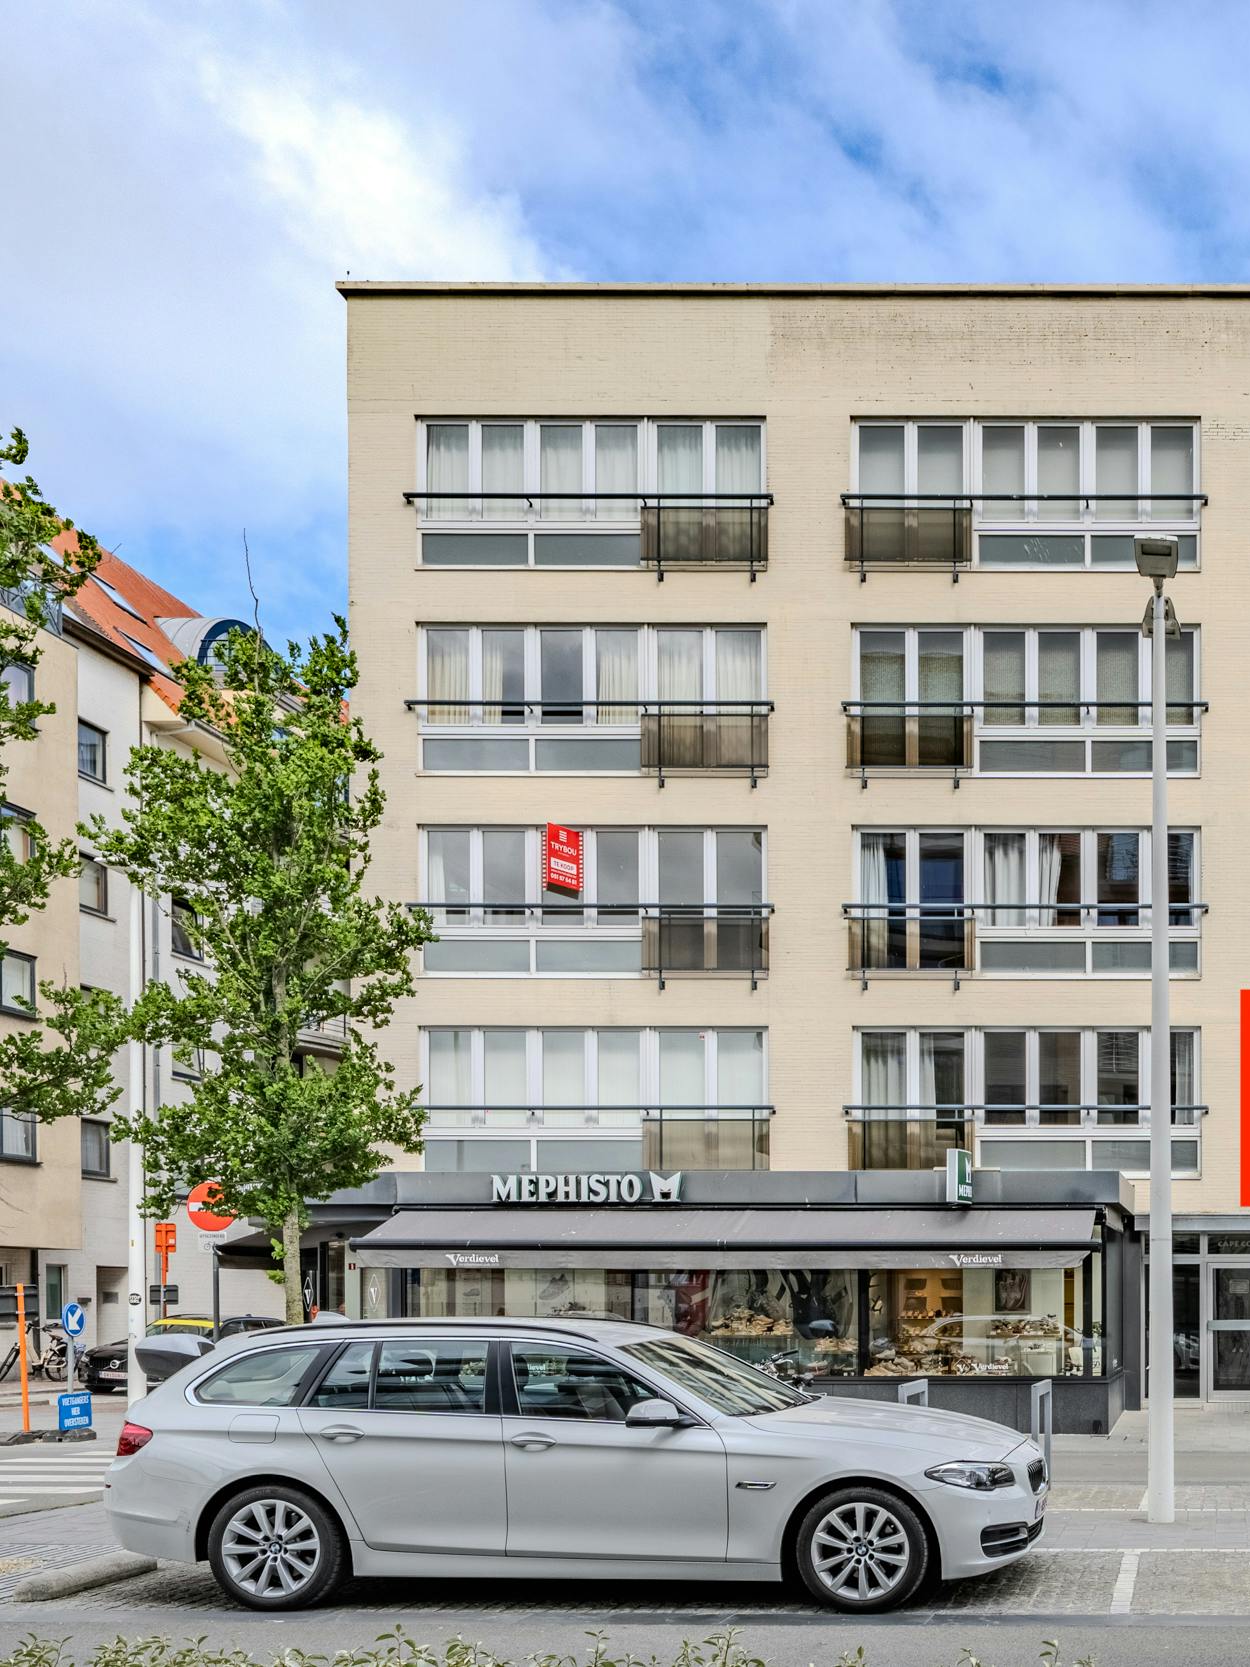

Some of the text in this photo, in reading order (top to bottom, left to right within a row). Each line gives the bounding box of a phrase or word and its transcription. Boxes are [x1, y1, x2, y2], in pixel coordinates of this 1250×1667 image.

[550, 841, 577, 856] TRYBOU
[490, 1174, 643, 1203] MEPHISTO
[1217, 1240, 1240, 1248] CAPE
[445, 1253, 499, 1266] Verdievel
[948, 1254, 1002, 1266] Verdievel
